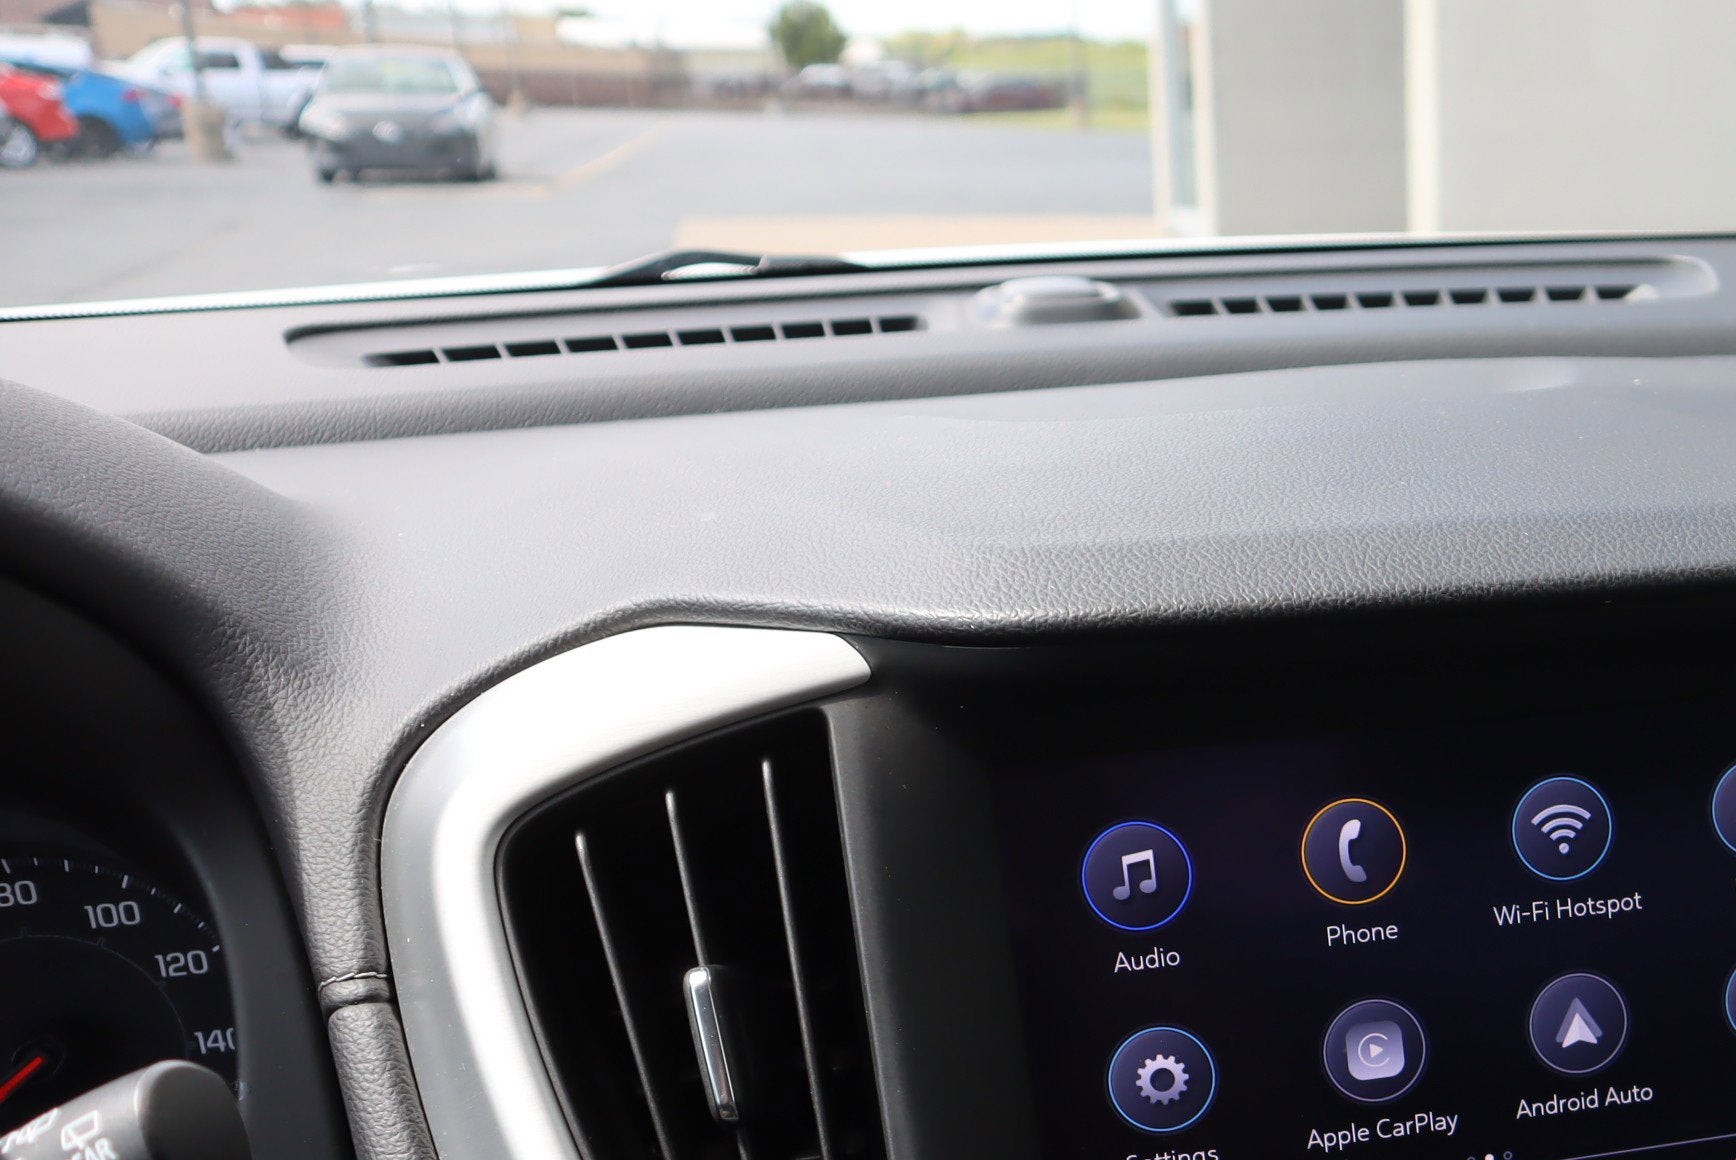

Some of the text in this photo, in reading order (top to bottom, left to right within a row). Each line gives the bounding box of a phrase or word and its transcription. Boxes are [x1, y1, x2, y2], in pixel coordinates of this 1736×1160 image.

[84, 901, 140, 928] 100
[1493, 892, 1642, 925] Wi-Fi Hotspot
[1327, 924, 1398, 946] Phone
[155, 951, 208, 977] 120
[1115, 947, 1180, 972] Audio
[1516, 1086, 1652, 1119] Android Auto
[1308, 1112, 1457, 1152] Apple CarPlay
